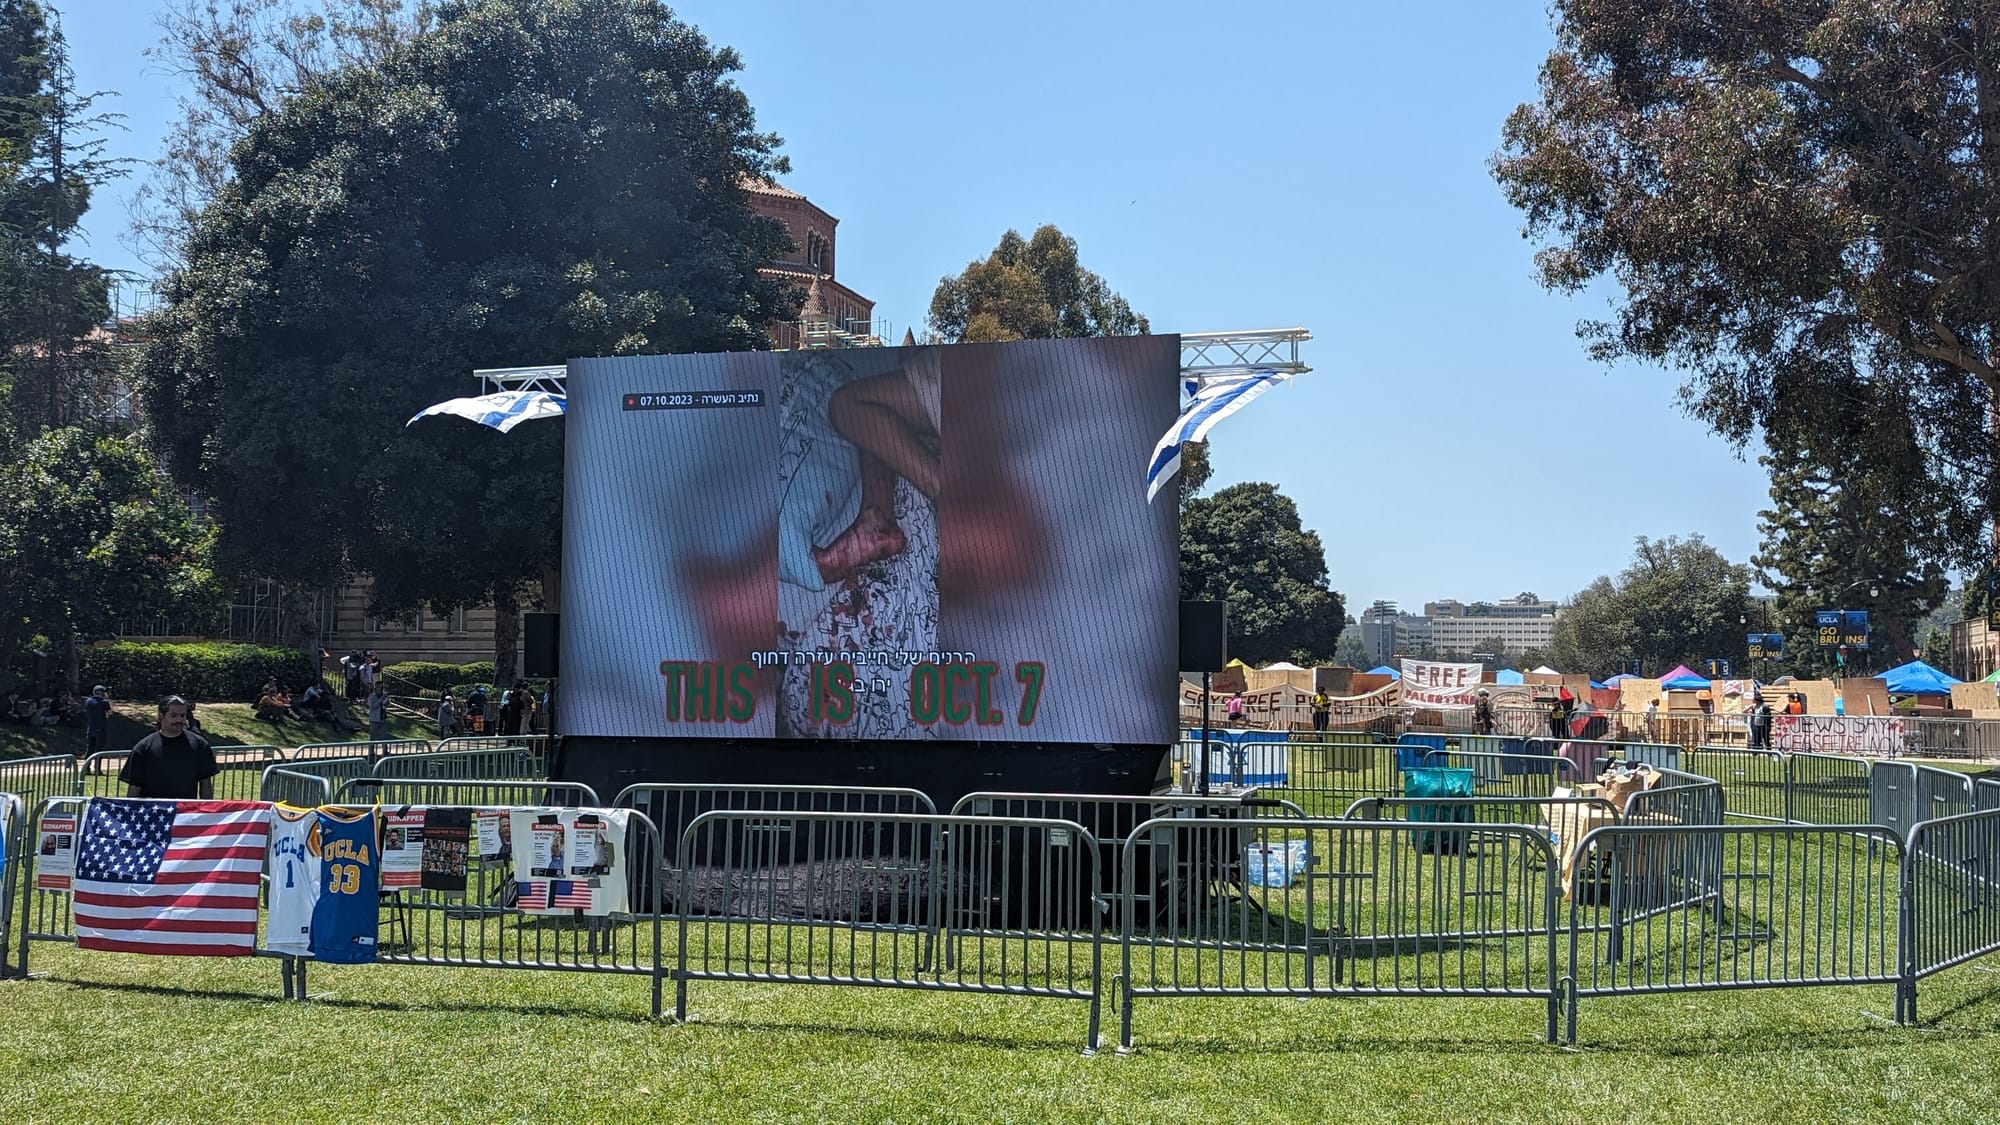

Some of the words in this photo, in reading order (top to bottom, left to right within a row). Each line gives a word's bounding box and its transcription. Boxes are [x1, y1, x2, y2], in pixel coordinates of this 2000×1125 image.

[640, 395, 692, 406] 07.10.2023
[701, 394, 736, 405] העשרה
[738, 393, 760, 404] נתיב
[1820, 626, 1837, 635] GO
[795, 651, 833, 666] עזרה
[895, 648, 922, 665] שלי
[872, 679, 890, 692] ירו
[1415, 665, 1467, 687] FREE
[661, 661, 756, 723] THIS
[809, 661, 856, 724] IS
[910, 661, 1004, 725] OCT.
[1015, 661, 1045, 726] 7
[1295, 689, 1399, 714] PESTINE
[1790, 717, 1846, 734] JEWS
[1854, 717, 1889, 734] SAY
[1780, 734, 1862, 753] CEASEFIRE
[1870, 736, 1905, 757] NOW
[273, 836, 305, 863] UCLA
[324, 839, 370, 866] UCLA
[285, 860, 294, 888] 1
[329, 863, 360, 895] 33
